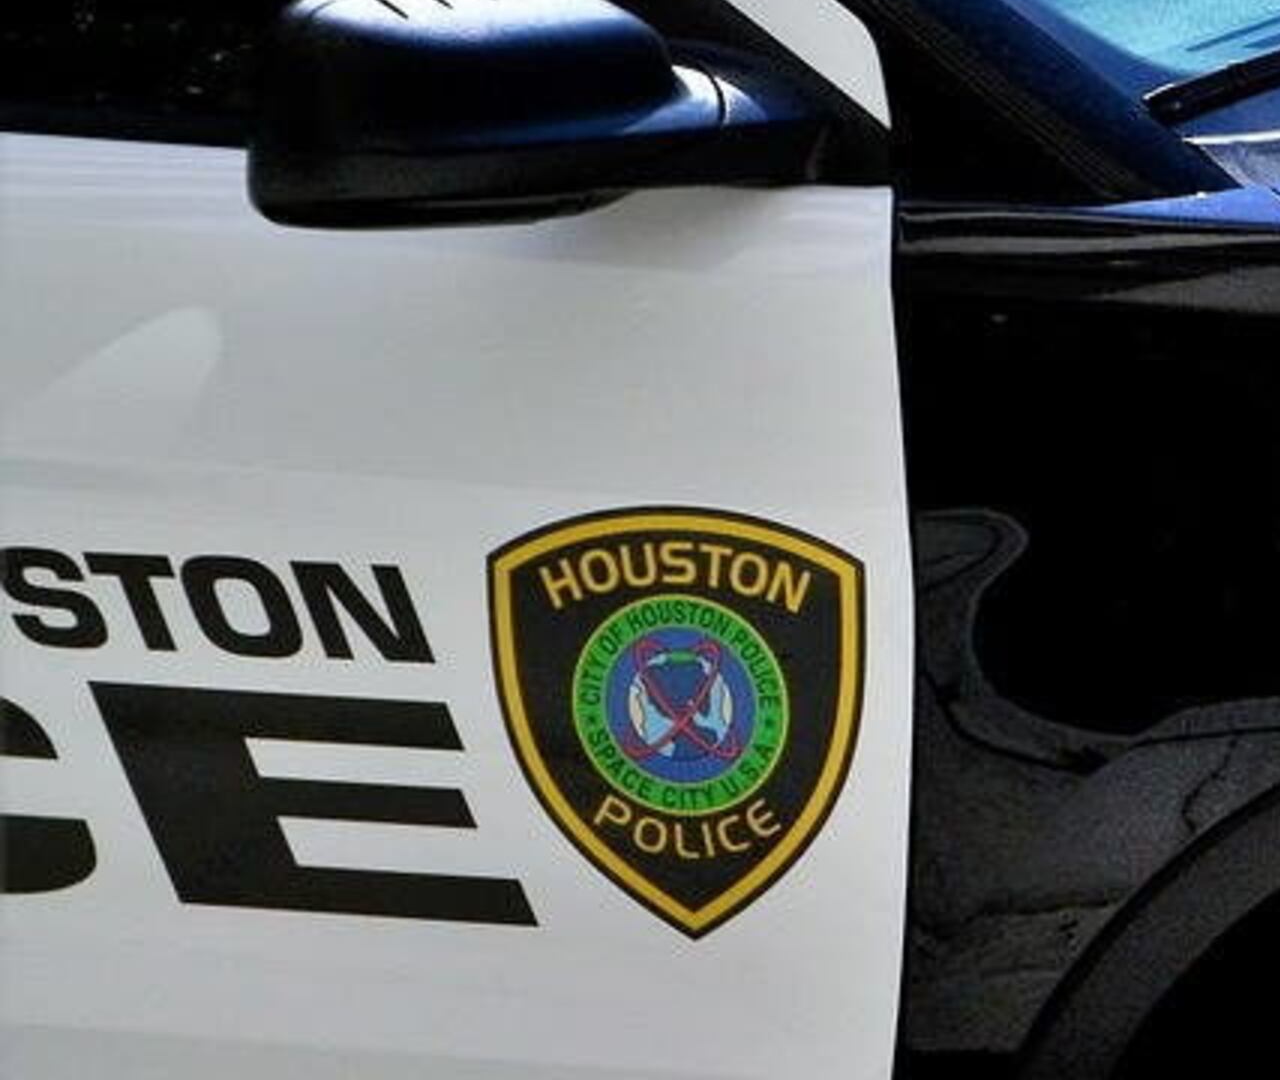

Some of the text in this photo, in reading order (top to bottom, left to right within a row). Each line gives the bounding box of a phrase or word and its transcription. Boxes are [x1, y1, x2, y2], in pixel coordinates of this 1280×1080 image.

[539, 542, 812, 614] HOUSTON
[581, 600, 778, 707] CITY OF HOUSTON POLICE
[588, 728, 653, 801] SPACE
[662, 787, 717, 808] CITY
[593, 796, 782, 859] POLICE
